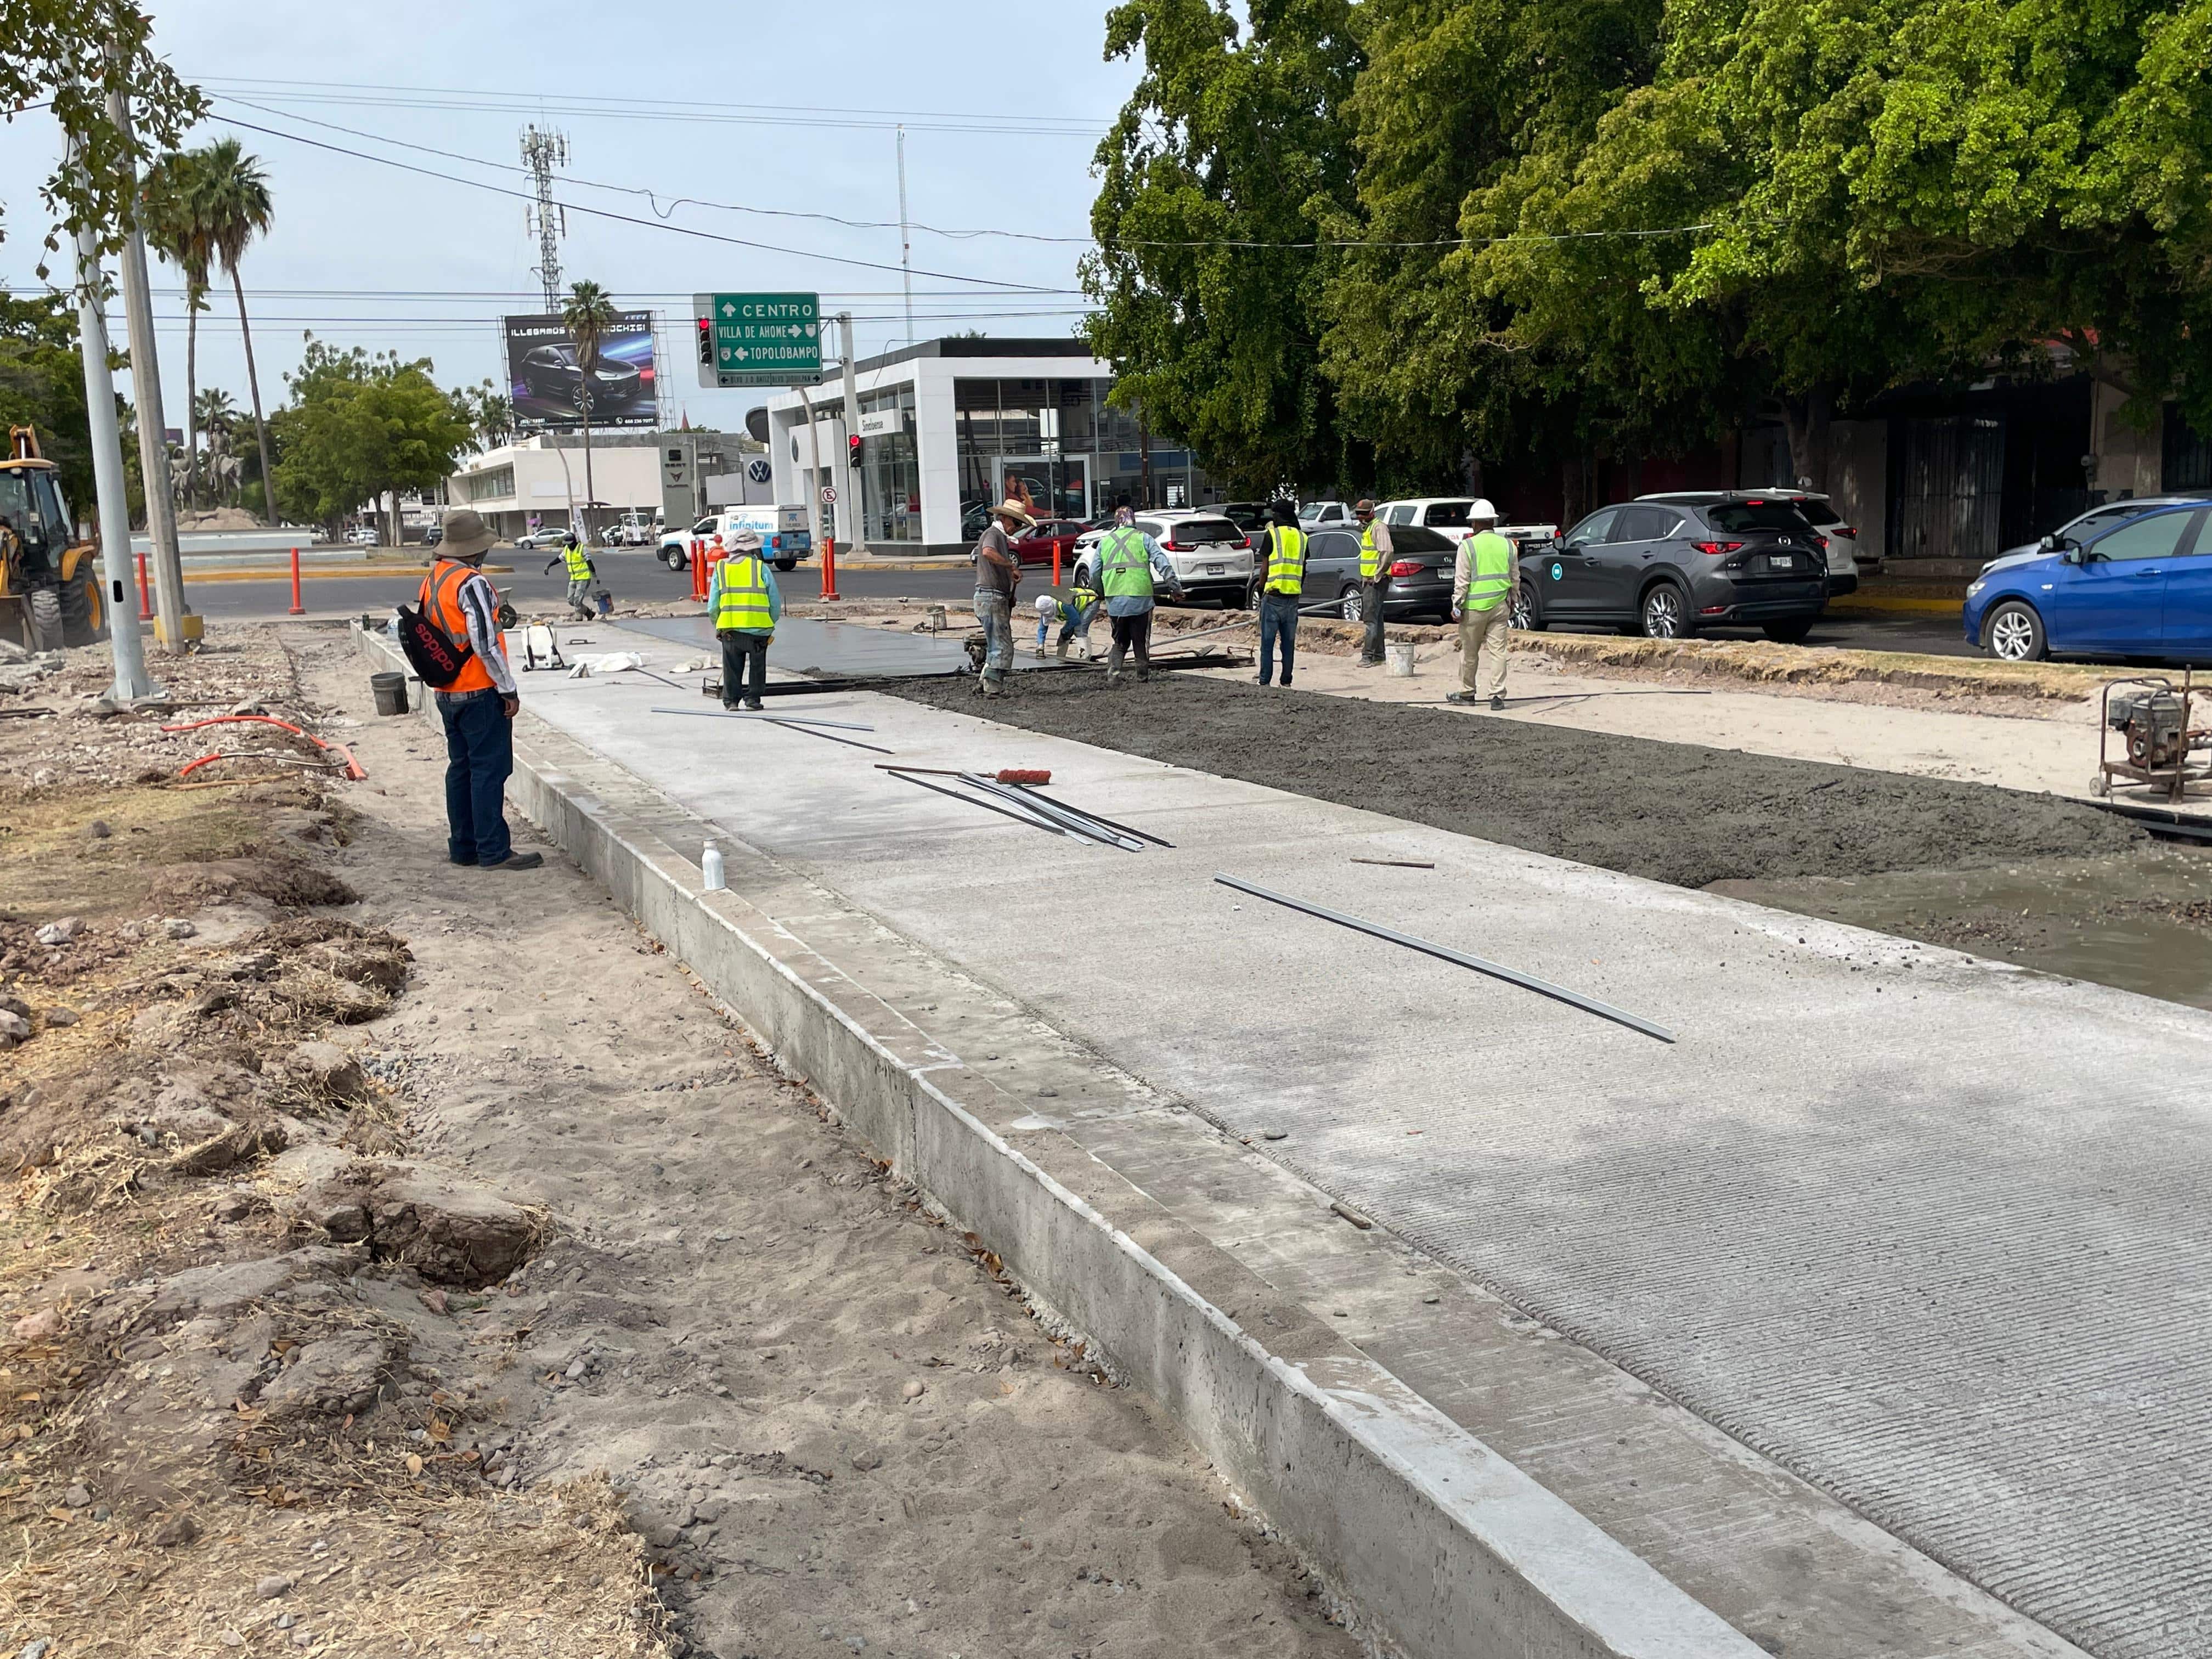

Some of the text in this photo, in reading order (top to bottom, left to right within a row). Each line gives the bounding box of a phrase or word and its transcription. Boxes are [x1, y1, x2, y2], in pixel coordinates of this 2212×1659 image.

[742, 304, 812, 317] CENTRO
[719, 325, 787, 338] VILLA DE AHOME
[751, 346, 818, 360] TOPOLOBAMPO
[730, 518, 774, 530] infinitum
[415, 623, 455, 672] adidas
